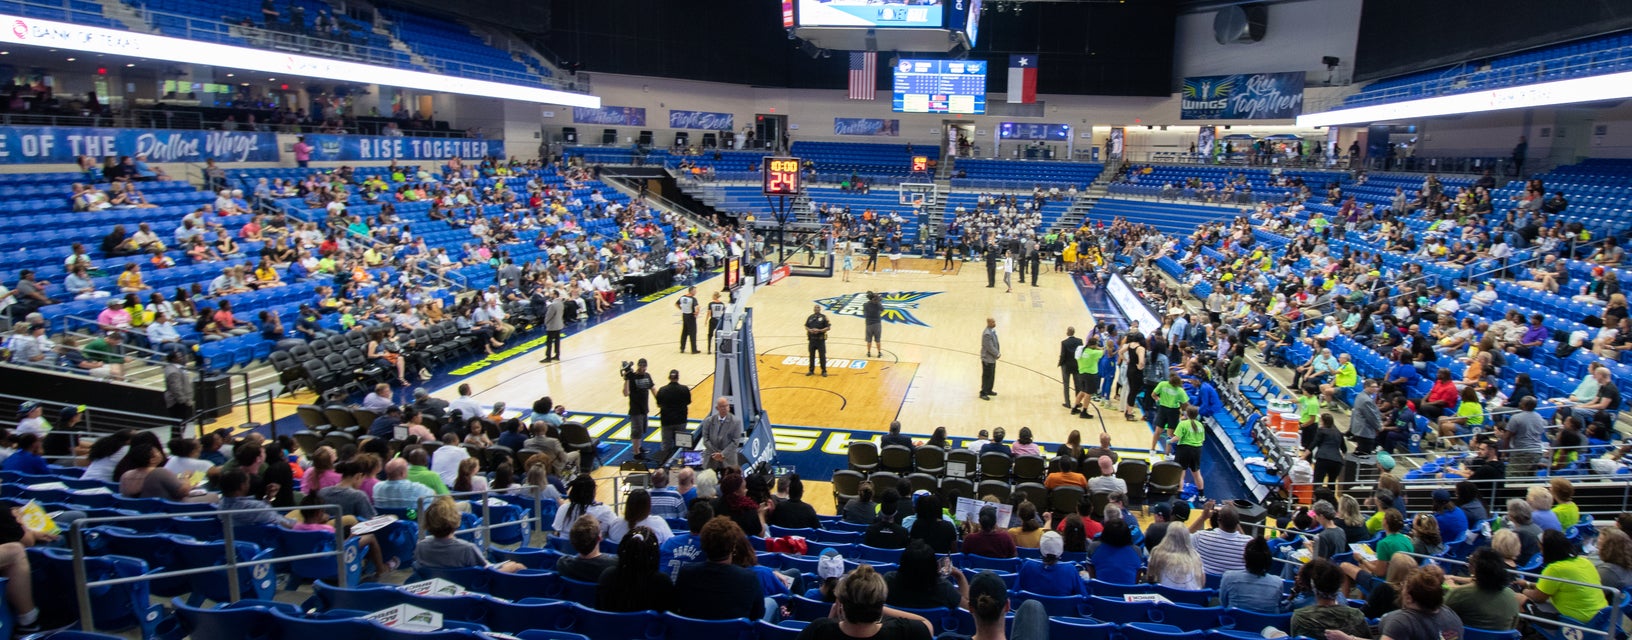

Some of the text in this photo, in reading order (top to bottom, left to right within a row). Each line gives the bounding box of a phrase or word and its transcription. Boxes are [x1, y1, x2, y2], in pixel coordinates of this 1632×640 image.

[1245, 74, 1277, 96] Rise
[1182, 98, 1228, 109] WINGS
[1232, 88, 1303, 119] Together
[21, 134, 55, 157] OF
[67, 135, 118, 157] THE
[136, 132, 200, 161] Dallas
[206, 131, 259, 162] Wings
[360, 138, 489, 159] RISE TOGETHER
[771, 160, 798, 172] 10:00
[770, 172, 796, 191] 24
